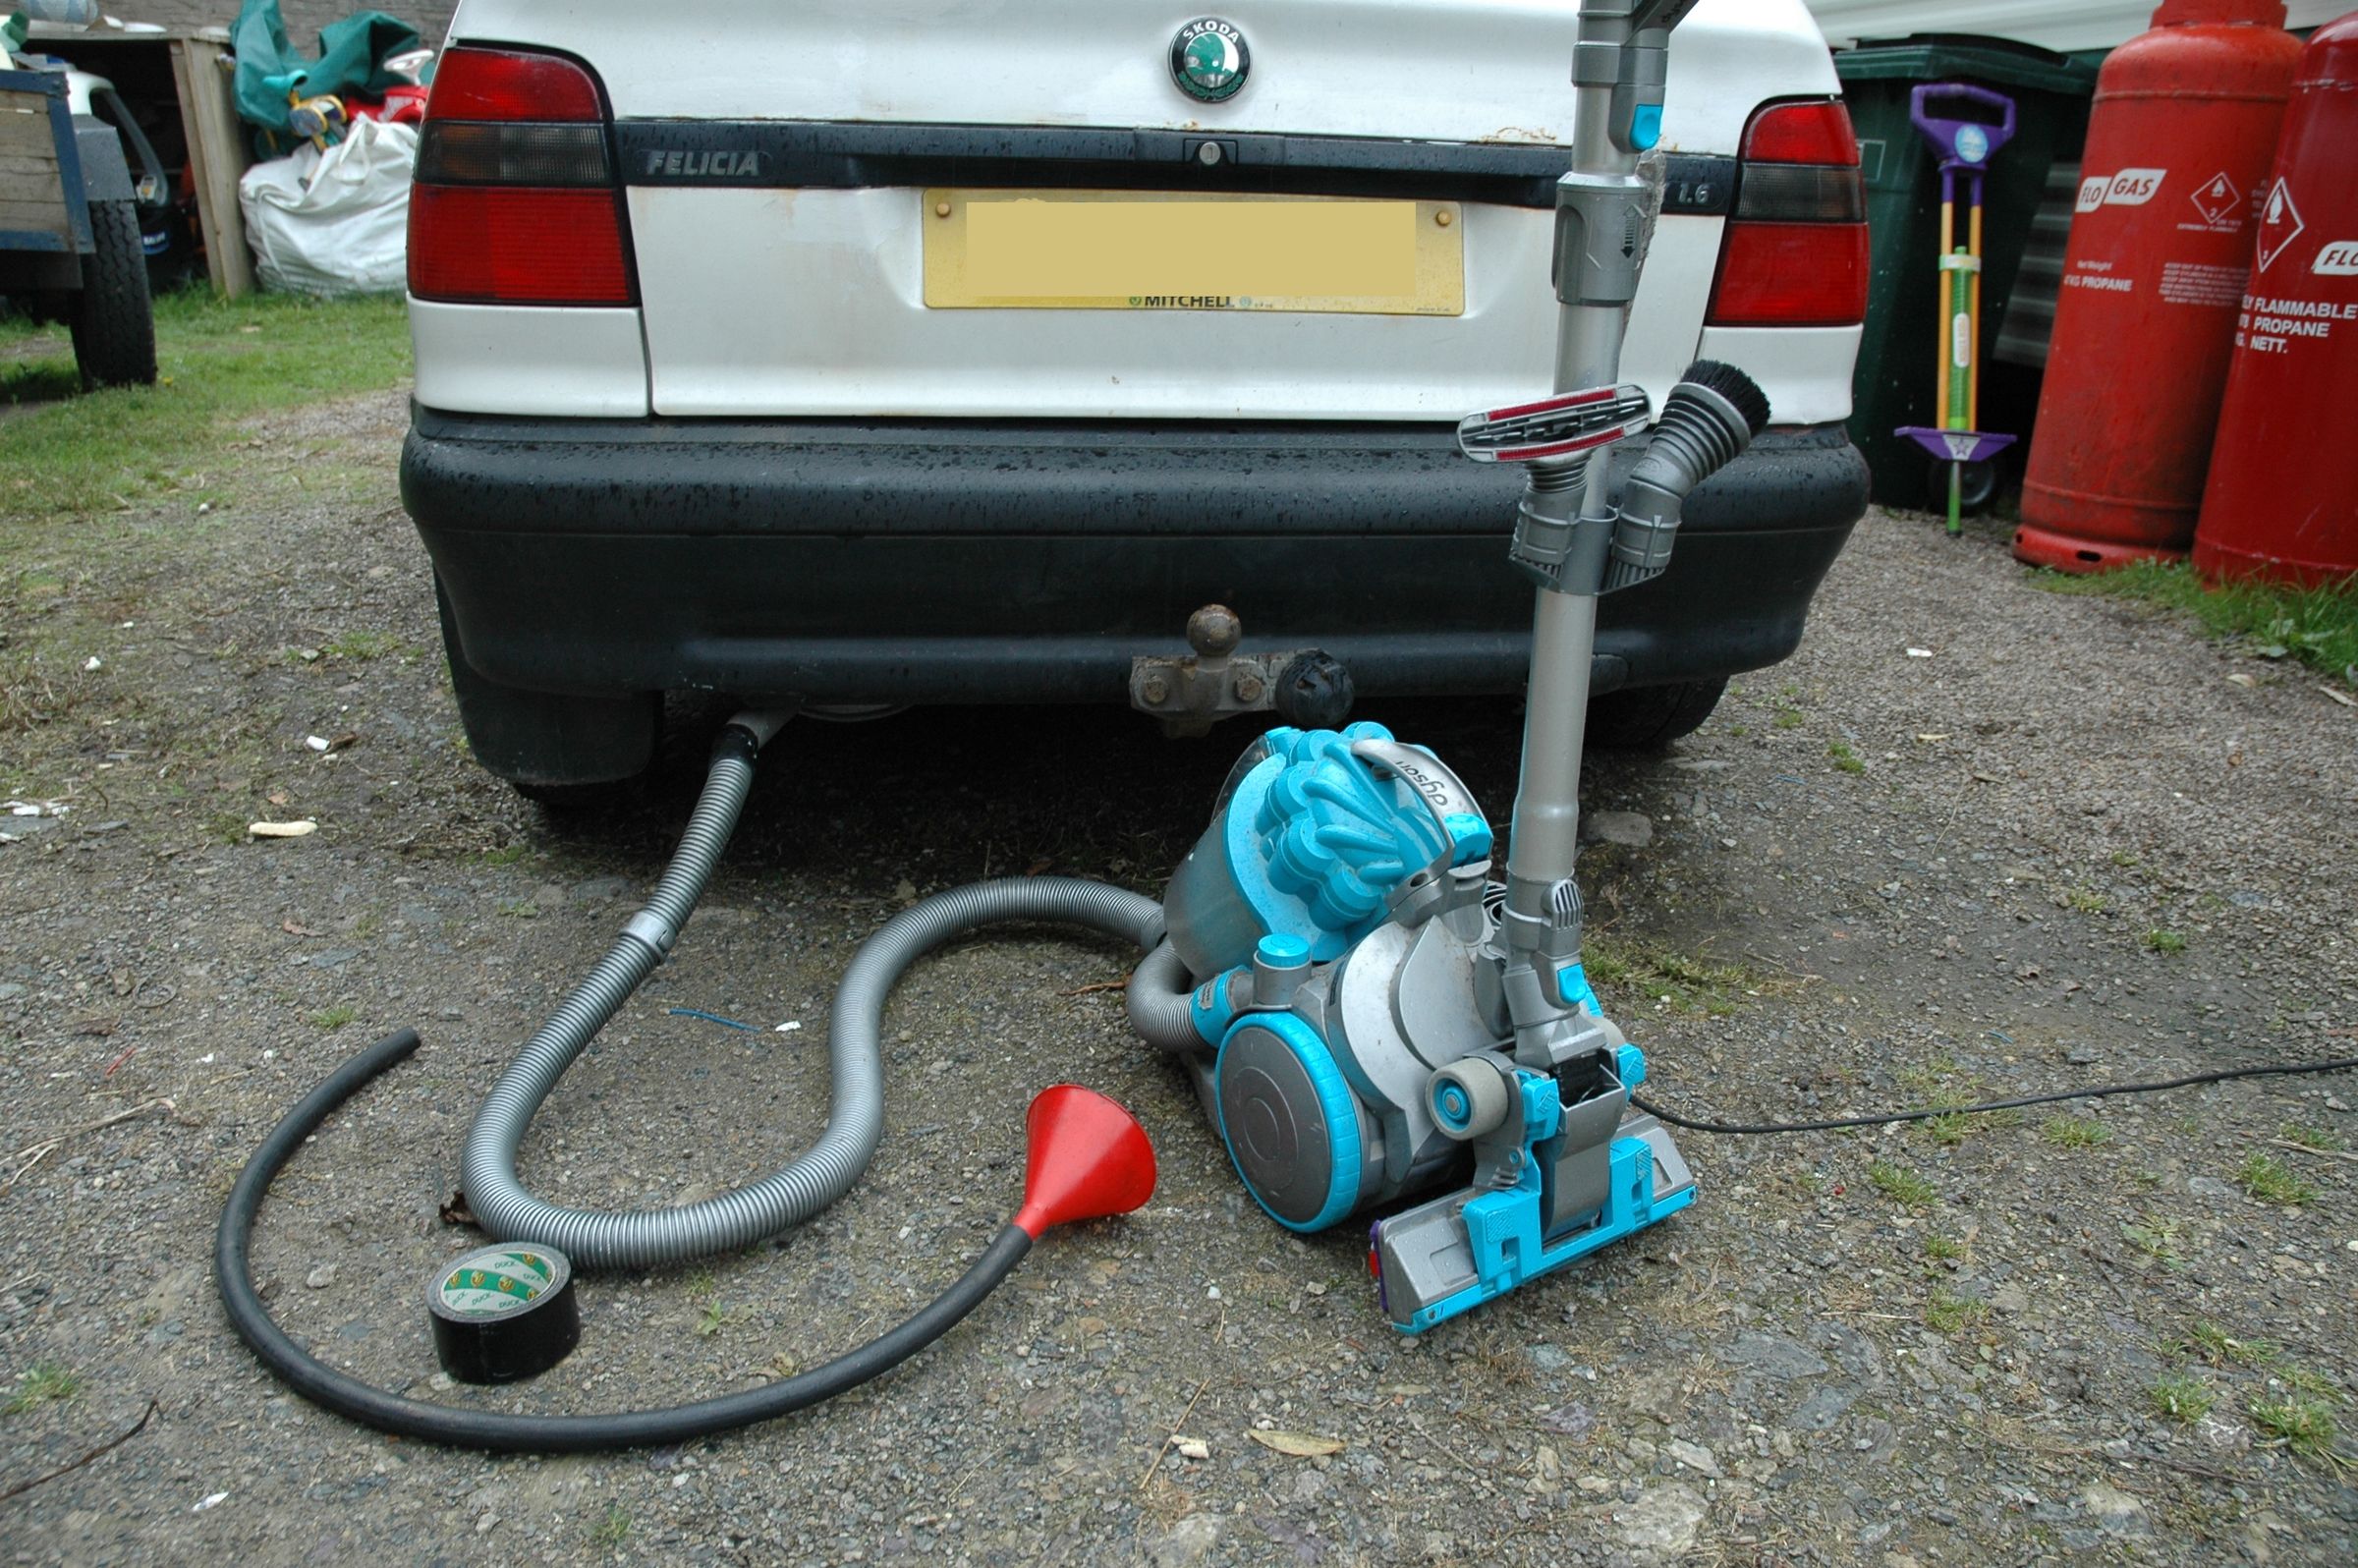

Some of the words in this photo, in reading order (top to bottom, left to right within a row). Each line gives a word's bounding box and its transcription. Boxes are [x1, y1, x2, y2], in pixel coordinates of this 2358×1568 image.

[646, 150, 760, 176] FELICIA
[1678, 183, 1710, 204] 1.6
[2081, 186, 2102, 203] FLO
[2113, 178, 2154, 196] GAS
[2081, 275, 2133, 292] PROPANE
[1145, 296, 1235, 308] MITCHELL
[2254, 297, 2358, 319] FLAMMABLE
[2253, 315, 2330, 338] PROPANE
[2250, 335, 2288, 354] NETT.
[1395, 760, 1448, 806] dyson
[494, 1260, 517, 1269] DUCK
[472, 1291, 491, 1306] DUCK
[498, 1299, 521, 1309] DUCK
